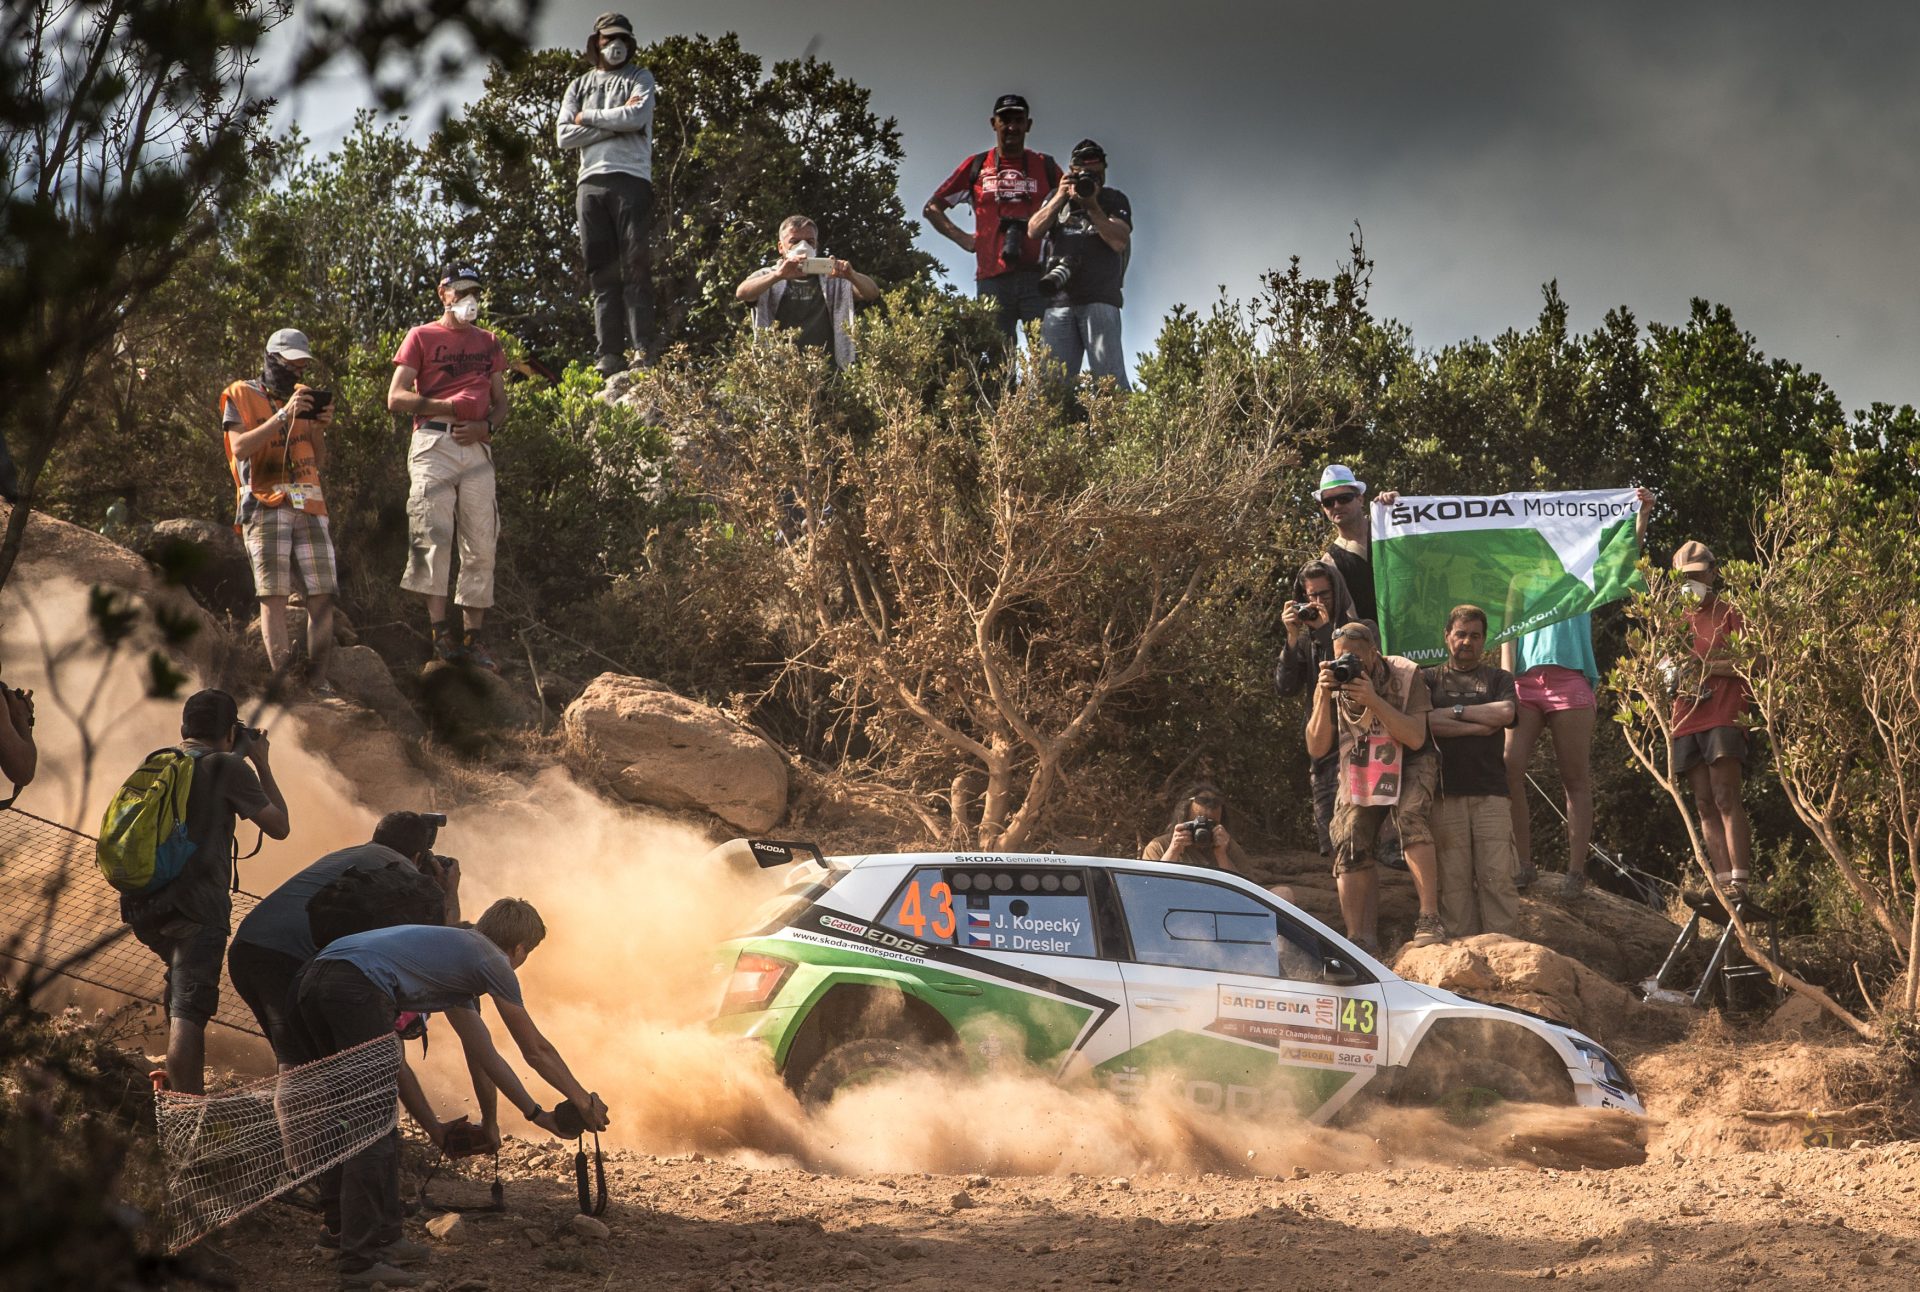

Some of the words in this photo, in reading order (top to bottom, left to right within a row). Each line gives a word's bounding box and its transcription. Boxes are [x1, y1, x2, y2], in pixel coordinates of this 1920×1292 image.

[1391, 499, 1515, 526] ŠKODA
[754, 842, 785, 855] ŠKODA
[898, 880, 956, 940] 43
[830, 919, 864, 935] Castrol
[866, 928, 930, 955] EDGE
[994, 916, 1008, 929] J.
[1013, 915, 1081, 936] Kopecký
[792, 931, 925, 965] www.skoda-motorsport.com
[995, 935, 1008, 949] P.
[1013, 935, 1071, 953] Dresler
[1222, 995, 1312, 1015] SARDEGNA
[1315, 997, 1334, 1026] 2016
[1341, 998, 1374, 1034] 43
[1250, 1026, 1261, 1034] FIA
[1263, 1027, 1277, 1035] WRC
[1279, 1028, 1284, 1036] 2
[1285, 1029, 1332, 1042] Championship
[1338, 1053, 1361, 1063] sara
[1110, 1066, 1300, 1116] ŠODA
